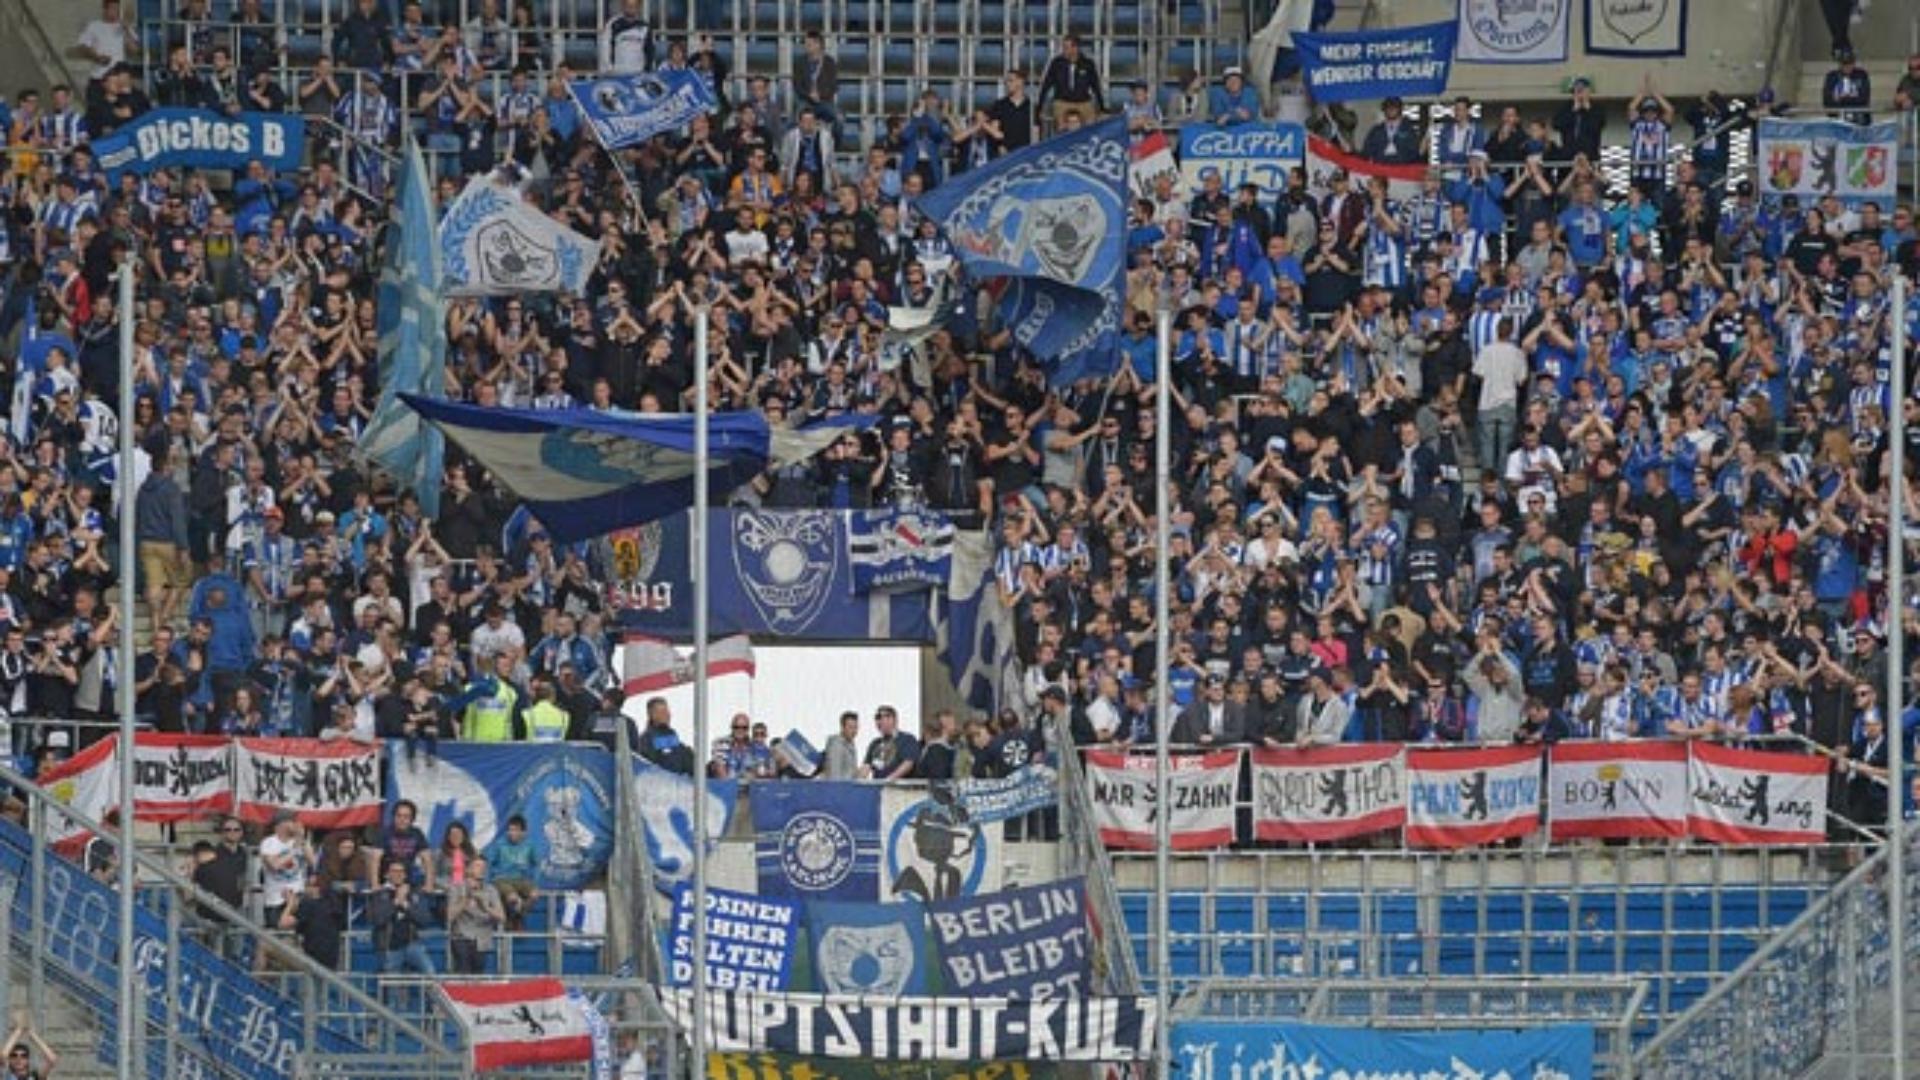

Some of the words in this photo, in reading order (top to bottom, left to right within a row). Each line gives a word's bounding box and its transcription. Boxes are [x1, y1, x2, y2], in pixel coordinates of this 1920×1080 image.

[262, 122, 285, 157] B
[1176, 783, 1232, 809] ZAHN
[933, 888, 1078, 944] BERLIN
[674, 935, 784, 972] SLTEN
[948, 928, 1084, 988] BLEIBT
